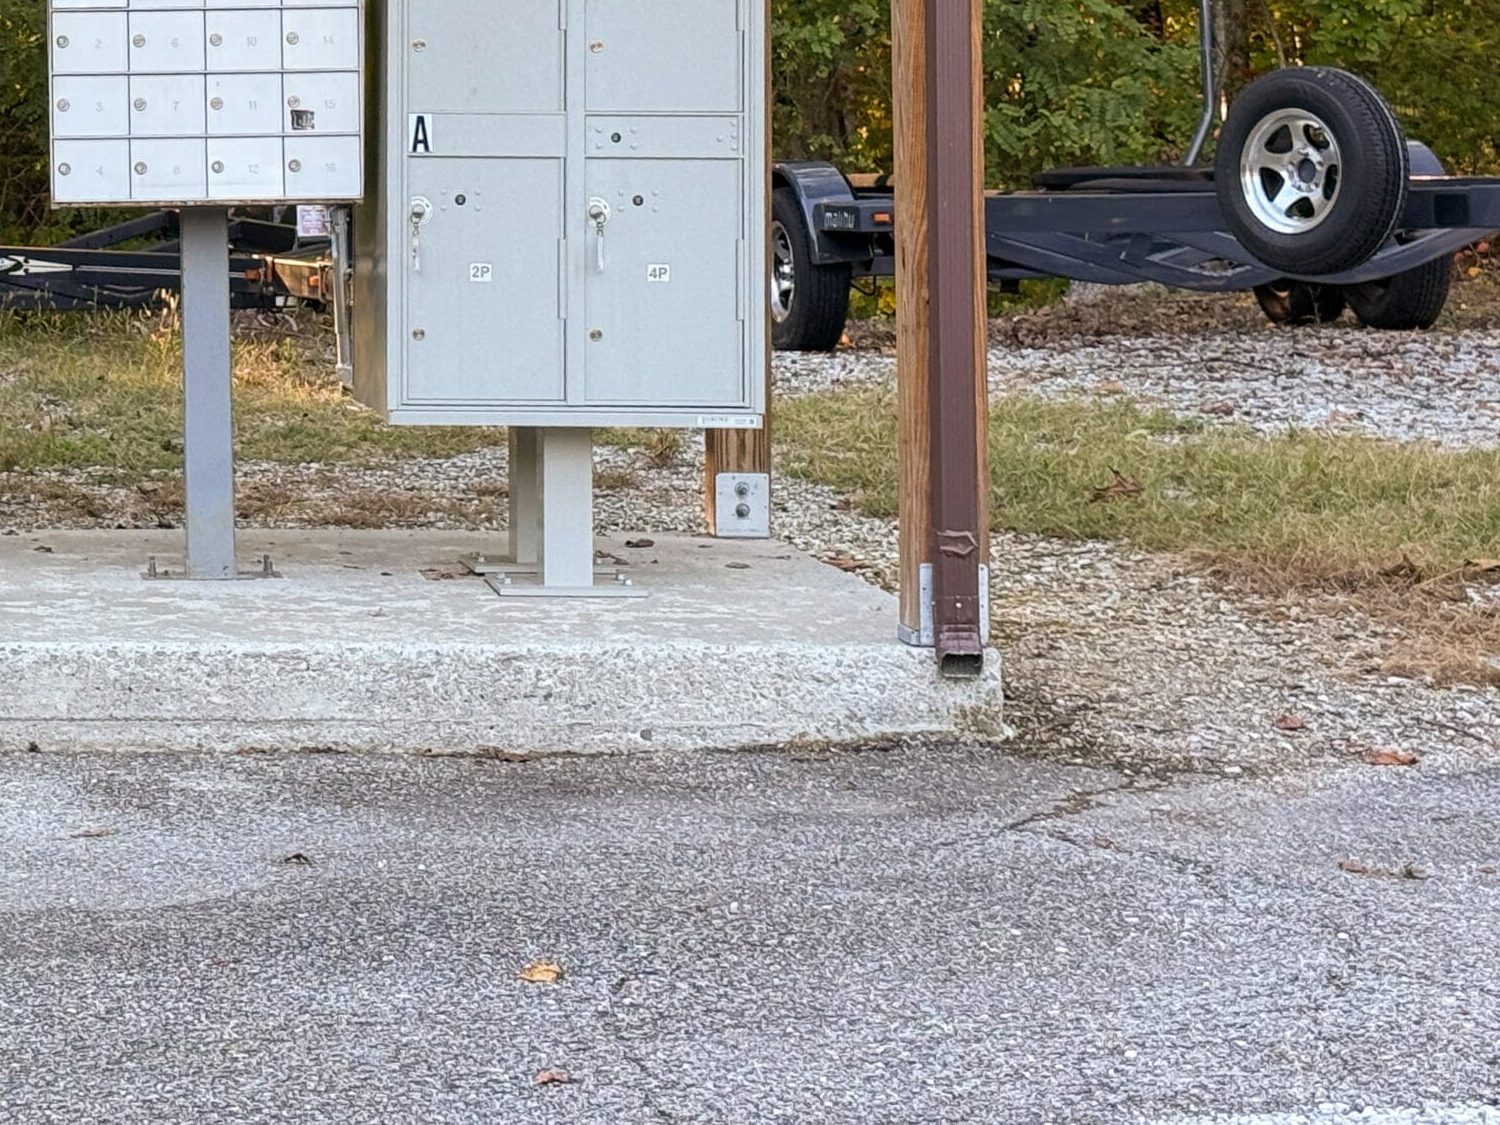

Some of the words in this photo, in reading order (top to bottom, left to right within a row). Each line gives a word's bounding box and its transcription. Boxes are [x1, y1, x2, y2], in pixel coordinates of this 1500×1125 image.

[412, 115, 430, 153] A
[471, 265, 490, 279] 2P
[648, 266, 668, 280] 4P
